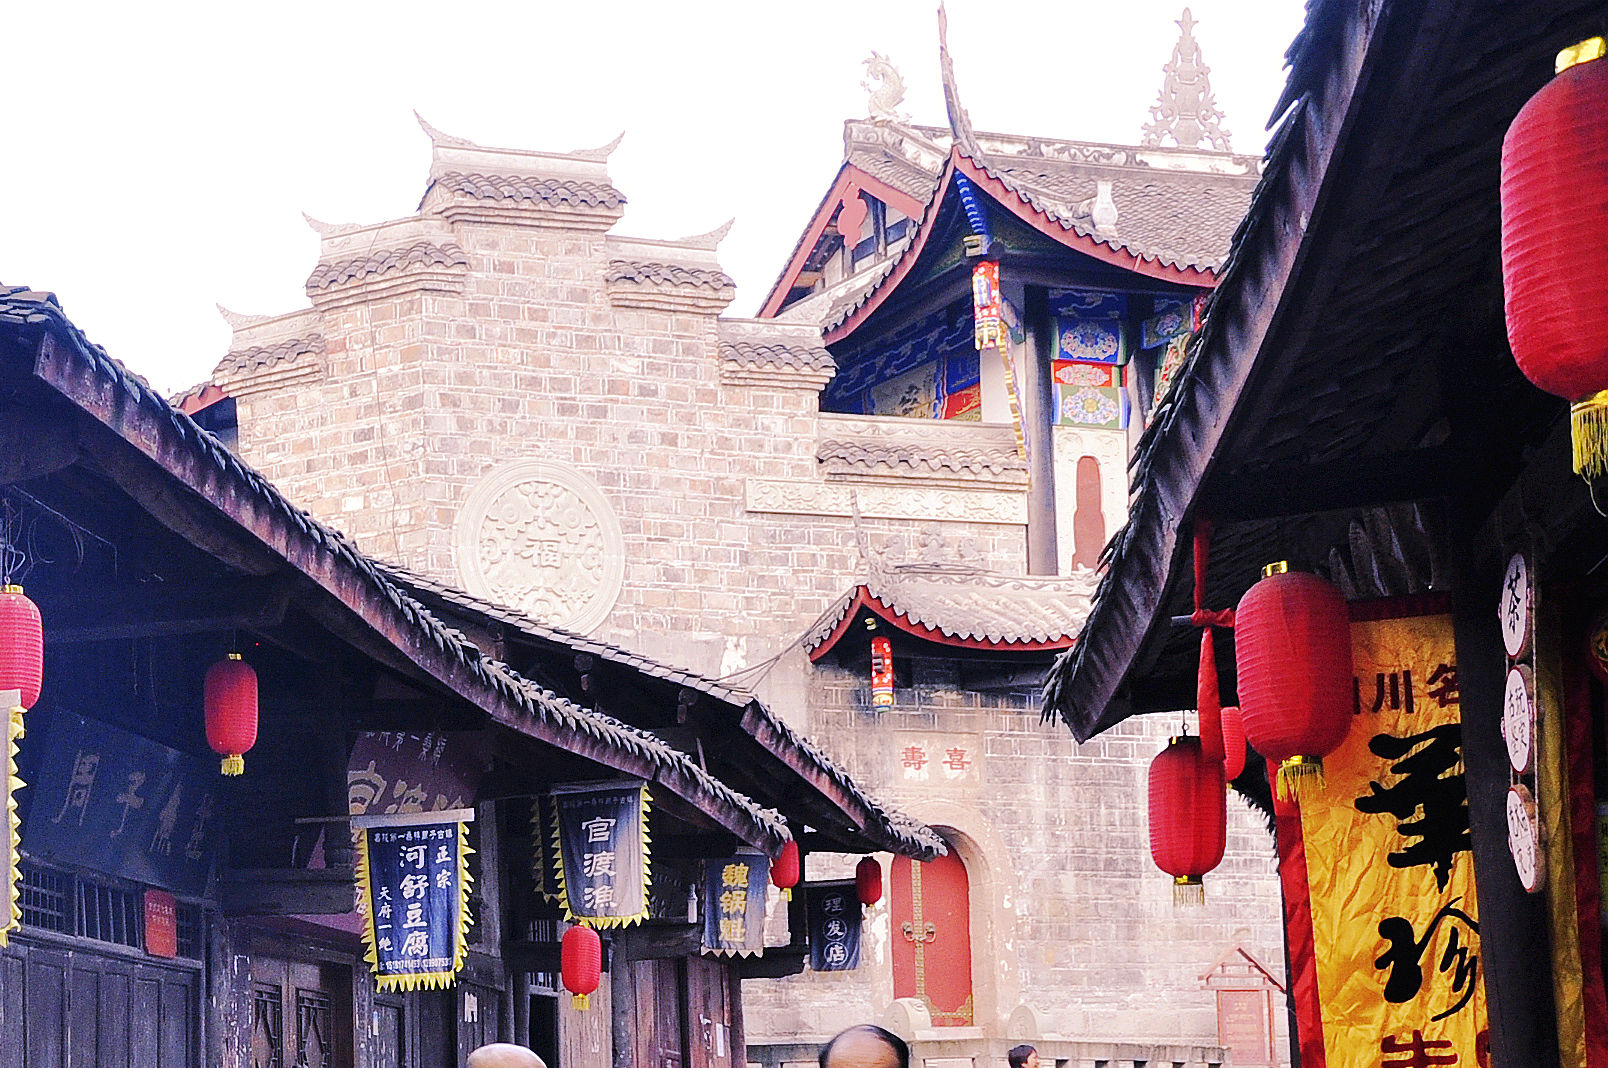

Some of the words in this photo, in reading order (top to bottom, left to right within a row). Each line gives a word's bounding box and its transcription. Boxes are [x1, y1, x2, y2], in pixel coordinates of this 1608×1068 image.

[1353, 663, 1460, 715] 川名
[399, 845, 430, 957] 河舒豆腐
[435, 845, 452, 889] 正宗
[377, 886, 394, 952] 天府一绝
[719, 862, 749, 943] 魏锅魁
[823, 893, 849, 965] 理发店
